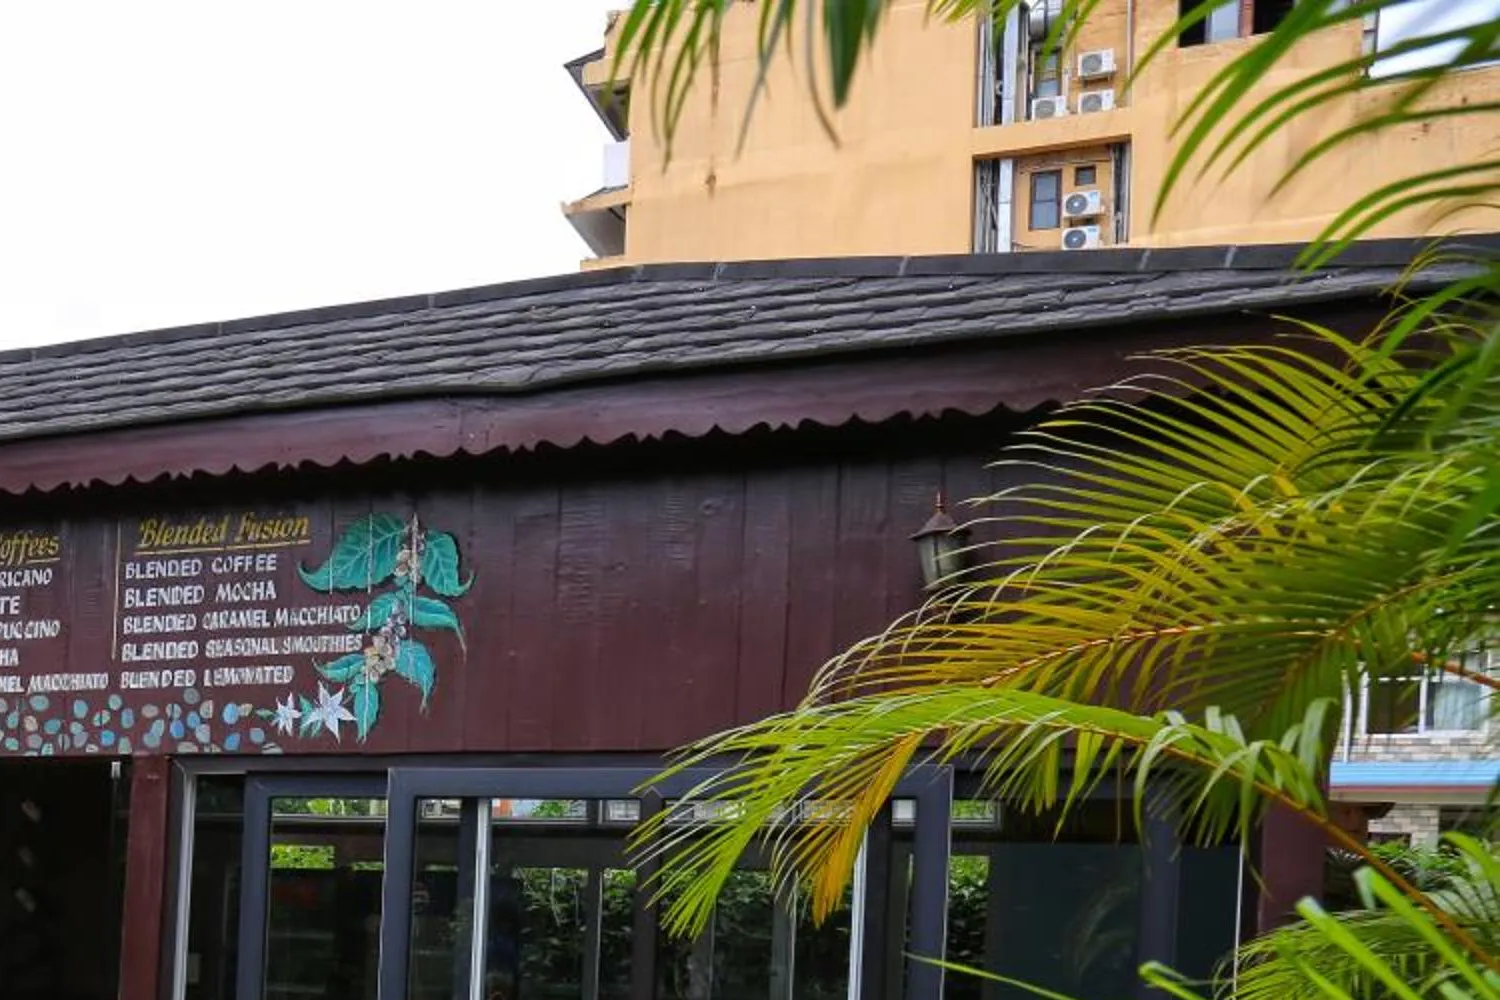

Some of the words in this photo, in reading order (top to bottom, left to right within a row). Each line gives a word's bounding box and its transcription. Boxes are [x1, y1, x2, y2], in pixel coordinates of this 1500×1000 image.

[139, 517, 228, 547] Blended
[234, 512, 309, 542] Fusion
[125, 559, 202, 579] BLENDED
[211, 554, 277, 573] COFFEE
[124, 585, 205, 608] BLENDED
[215, 580, 277, 601] MOCHA
[123, 614, 197, 635] BLENDED
[202, 609, 271, 630] CARAMEL
[273, 605, 360, 627] MACCHIATO
[121, 641, 199, 662] BLENDED
[205, 638, 278, 658] SEASONAL
[282, 634, 363, 654] SMOOTHIES
[28, 672, 109, 694] MACCHIATO
[120, 669, 197, 689] BLENDED
